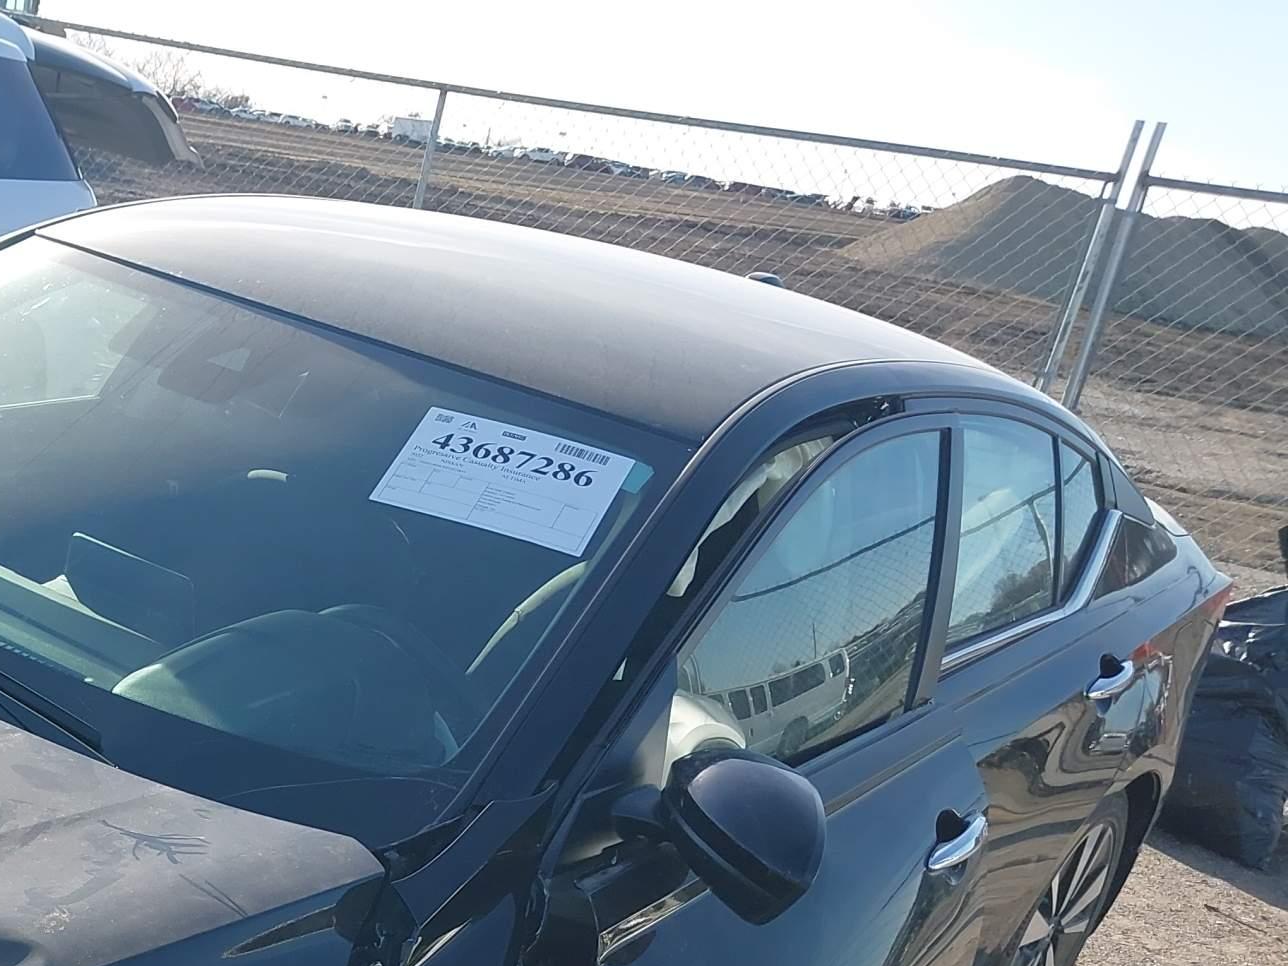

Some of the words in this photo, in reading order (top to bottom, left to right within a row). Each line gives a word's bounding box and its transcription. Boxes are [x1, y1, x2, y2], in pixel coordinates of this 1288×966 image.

[413, 444, 463, 461] Progressive
[463, 456, 499, 471] Casualty
[500, 465, 542, 481] Insurance
[431, 432, 600, 488] 43687286
